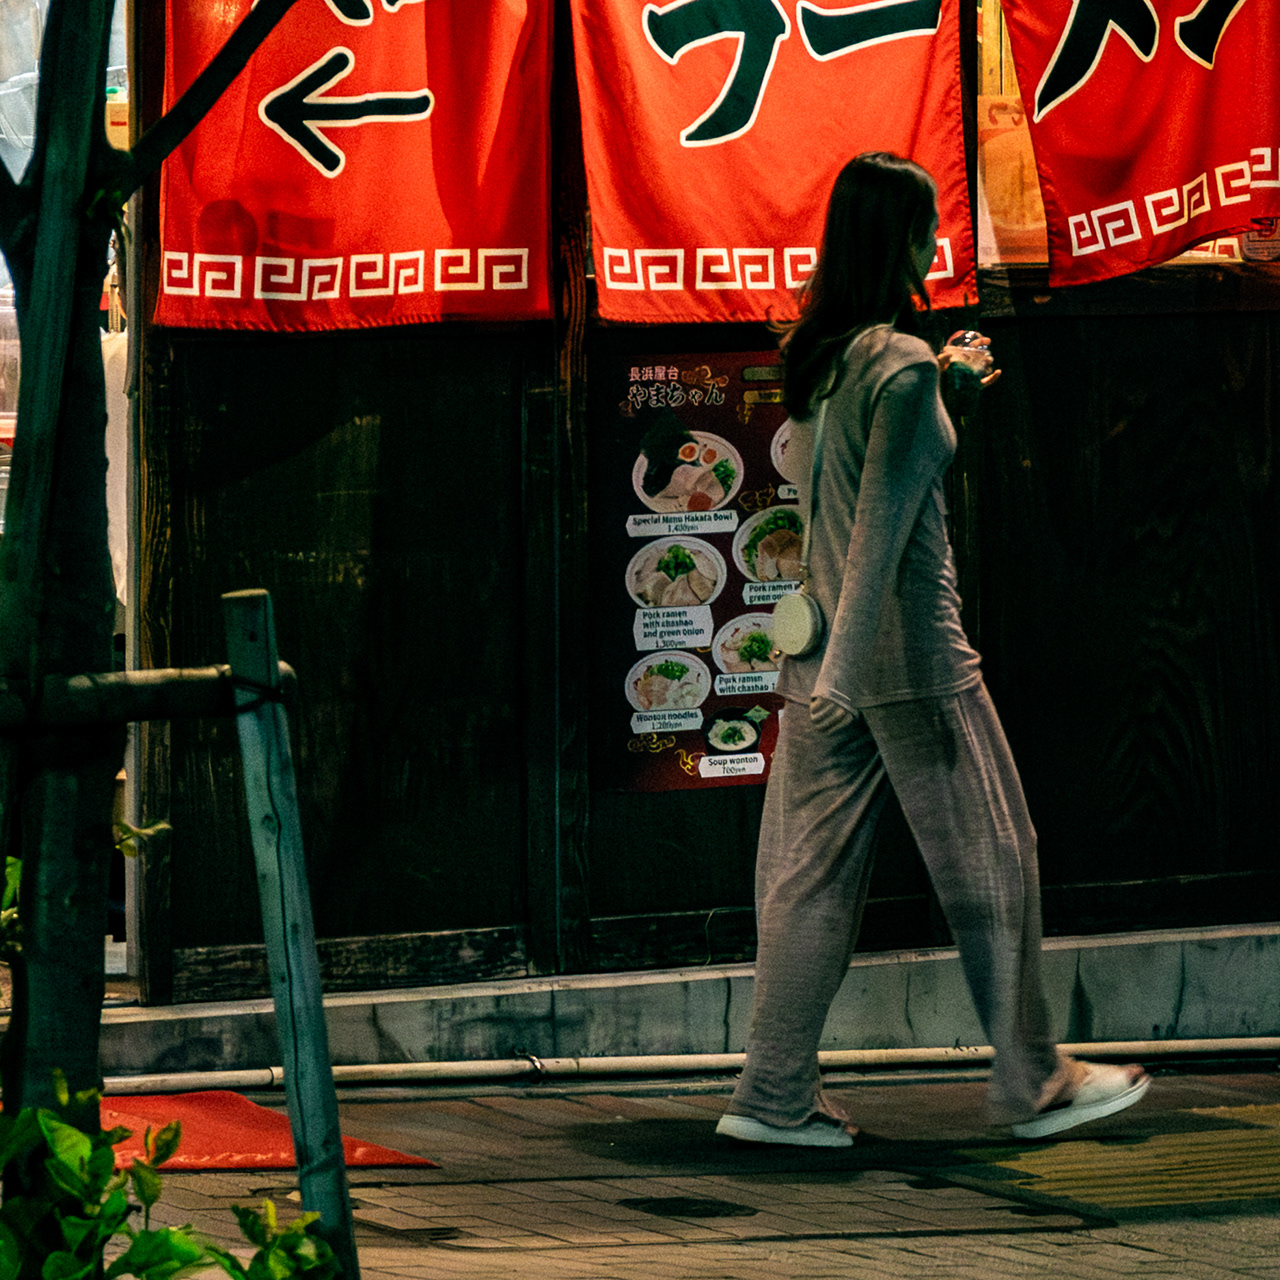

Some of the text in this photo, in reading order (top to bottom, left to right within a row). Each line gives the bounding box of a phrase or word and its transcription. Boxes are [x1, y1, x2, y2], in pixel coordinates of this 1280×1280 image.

[628, 366, 680, 382] 長浜屋台
[627, 381, 726, 410] やまちゃん
[713, 512, 733, 521] Bowl
[749, 584, 767, 592] Pork
[642, 610, 687, 619] Pork ramen
[643, 629, 658, 638] and
[719, 684, 737, 693] with
[708, 758, 728, 766] Soup
